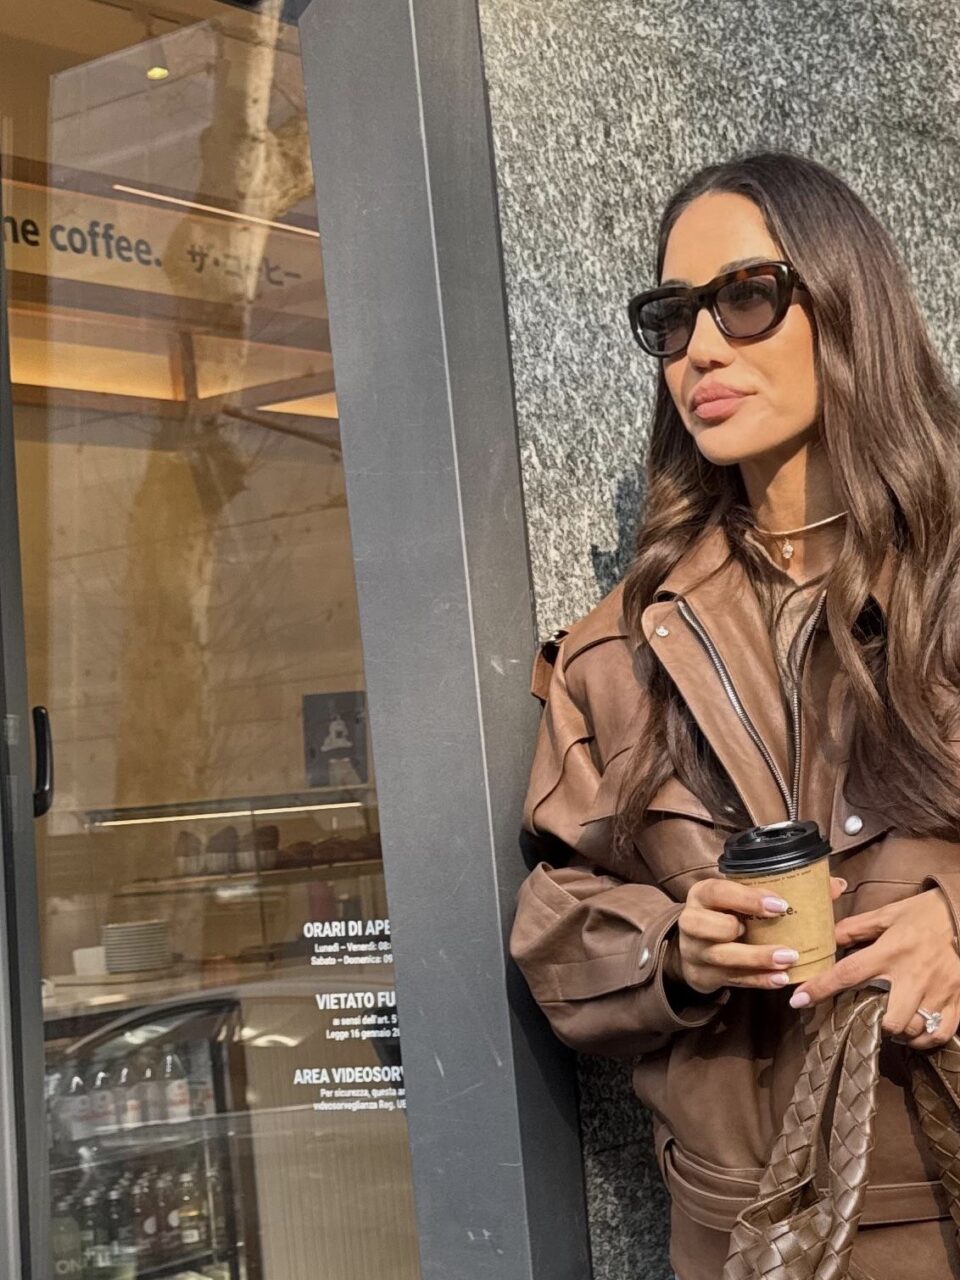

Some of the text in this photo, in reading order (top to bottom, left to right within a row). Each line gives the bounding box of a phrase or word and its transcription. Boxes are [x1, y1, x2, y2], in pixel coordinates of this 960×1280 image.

[50, 220, 162, 267] coffee.
[303, 921, 346, 938] ORARI
[348, 920, 362, 936] DI
[315, 991, 396, 1010] VIETATO FU
[326, 1030, 349, 1041] Legge
[350, 1029, 360, 1038] 16
[293, 1068, 330, 1085] AREA
[320, 1088, 333, 1098] Per
